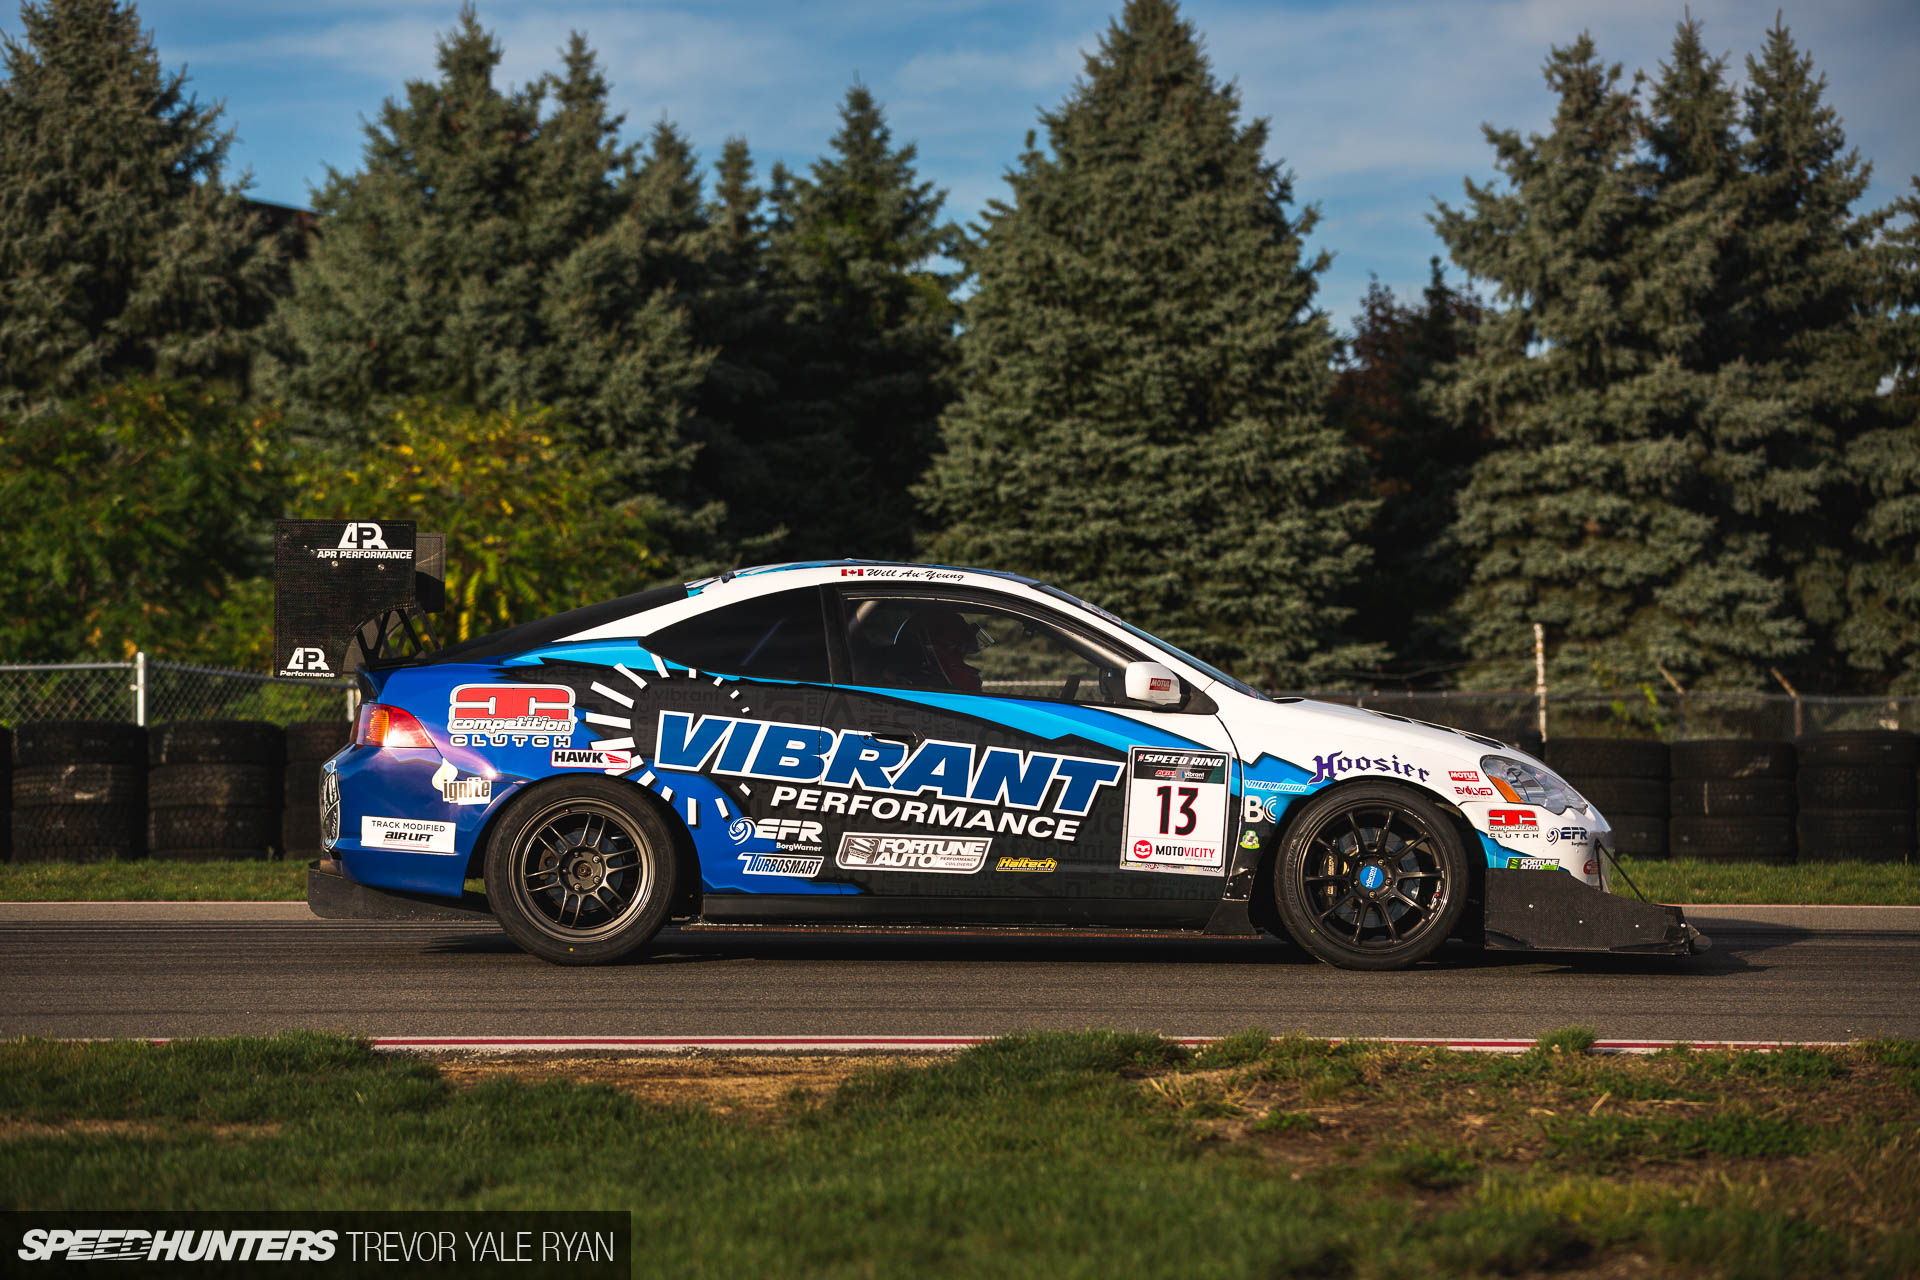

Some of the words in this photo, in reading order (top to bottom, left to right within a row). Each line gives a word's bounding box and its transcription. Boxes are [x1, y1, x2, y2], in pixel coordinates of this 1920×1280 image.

[317, 551, 337, 559] APR
[340, 551, 412, 560] PERFORMANCE
[866, 568, 898, 577] Will
[280, 670, 335, 678] Performance
[452, 716, 571, 734] competition
[451, 735, 571, 747] CLUTCH
[554, 751, 604, 763] HAWK
[653, 710, 1127, 816] VIBRANT
[1307, 750, 1430, 785] Hoosier
[443, 779, 490, 802] ignite
[1454, 785, 1494, 796] EVOLVED
[769, 786, 1082, 843] PERFORMANCE
[1157, 785, 1199, 836] 13
[372, 820, 401, 829] TRACK
[403, 822, 446, 833] MODIFIED
[754, 818, 823, 843] EFR
[1489, 824, 1539, 833] competition
[1560, 826, 1588, 840] EFR
[776, 842, 822, 852] BorgWarner
[880, 838, 987, 856] FORTUNE
[1155, 845, 1216, 859] MOTOVICITY
[742, 853, 823, 875] TURBOSMART
[875, 852, 937, 868] AUTO
[1000, 858, 1057, 868] Haltech
[1520, 858, 1560, 866] FORTUNE
